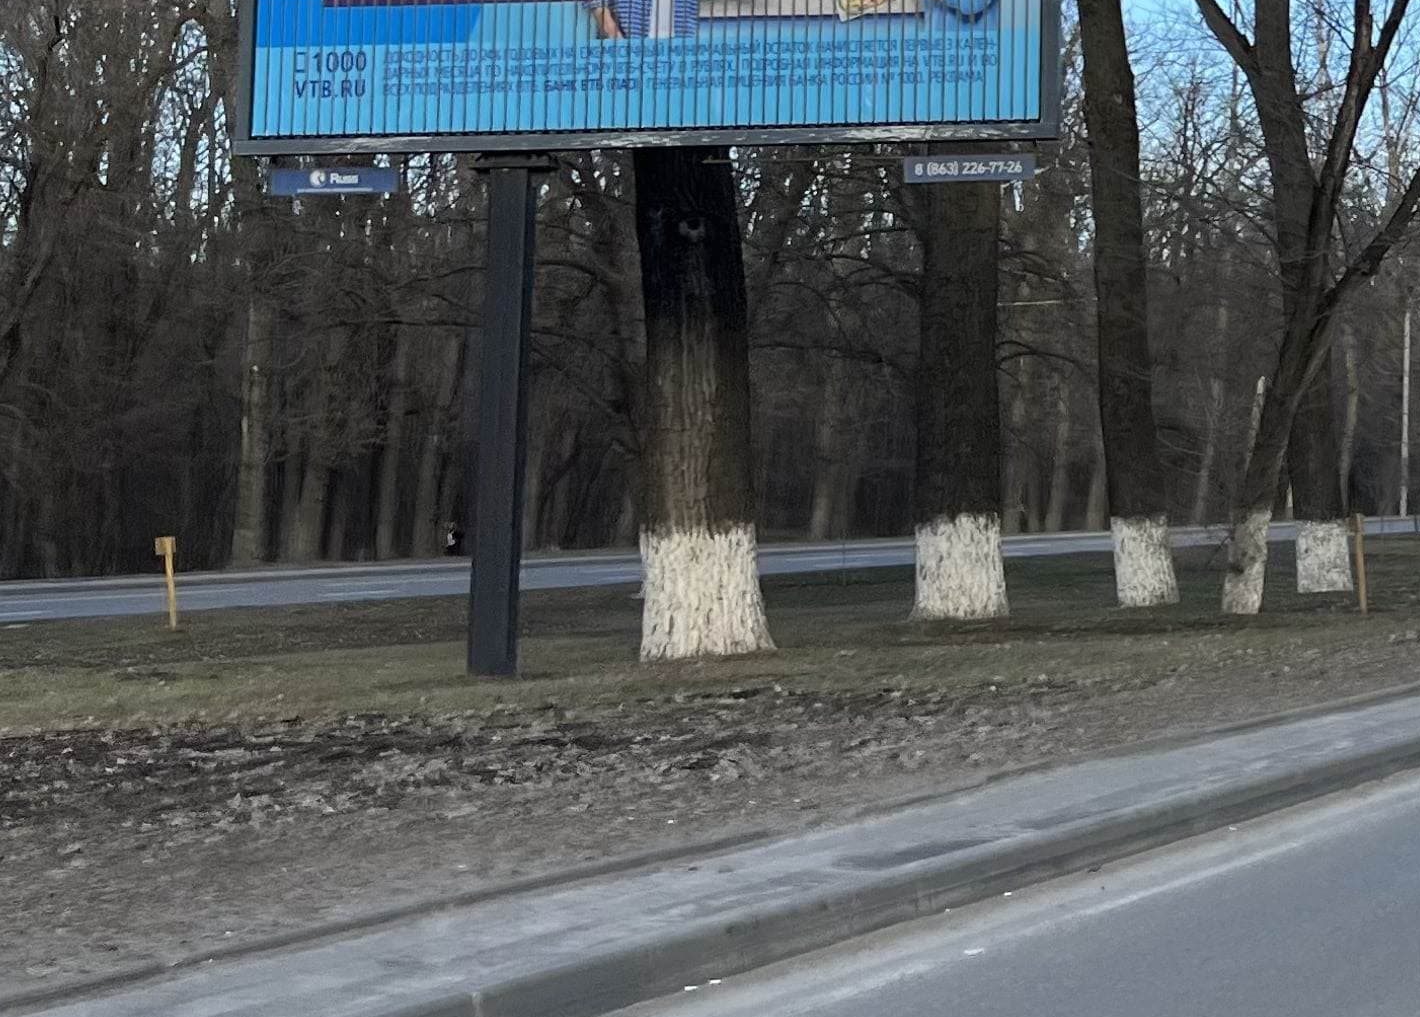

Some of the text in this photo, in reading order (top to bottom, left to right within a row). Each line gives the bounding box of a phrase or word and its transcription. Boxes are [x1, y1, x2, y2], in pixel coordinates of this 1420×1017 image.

[294, 78, 366, 98] VTB.RU
[914, 161, 1023, 176] 8 (863) 226-77-26
